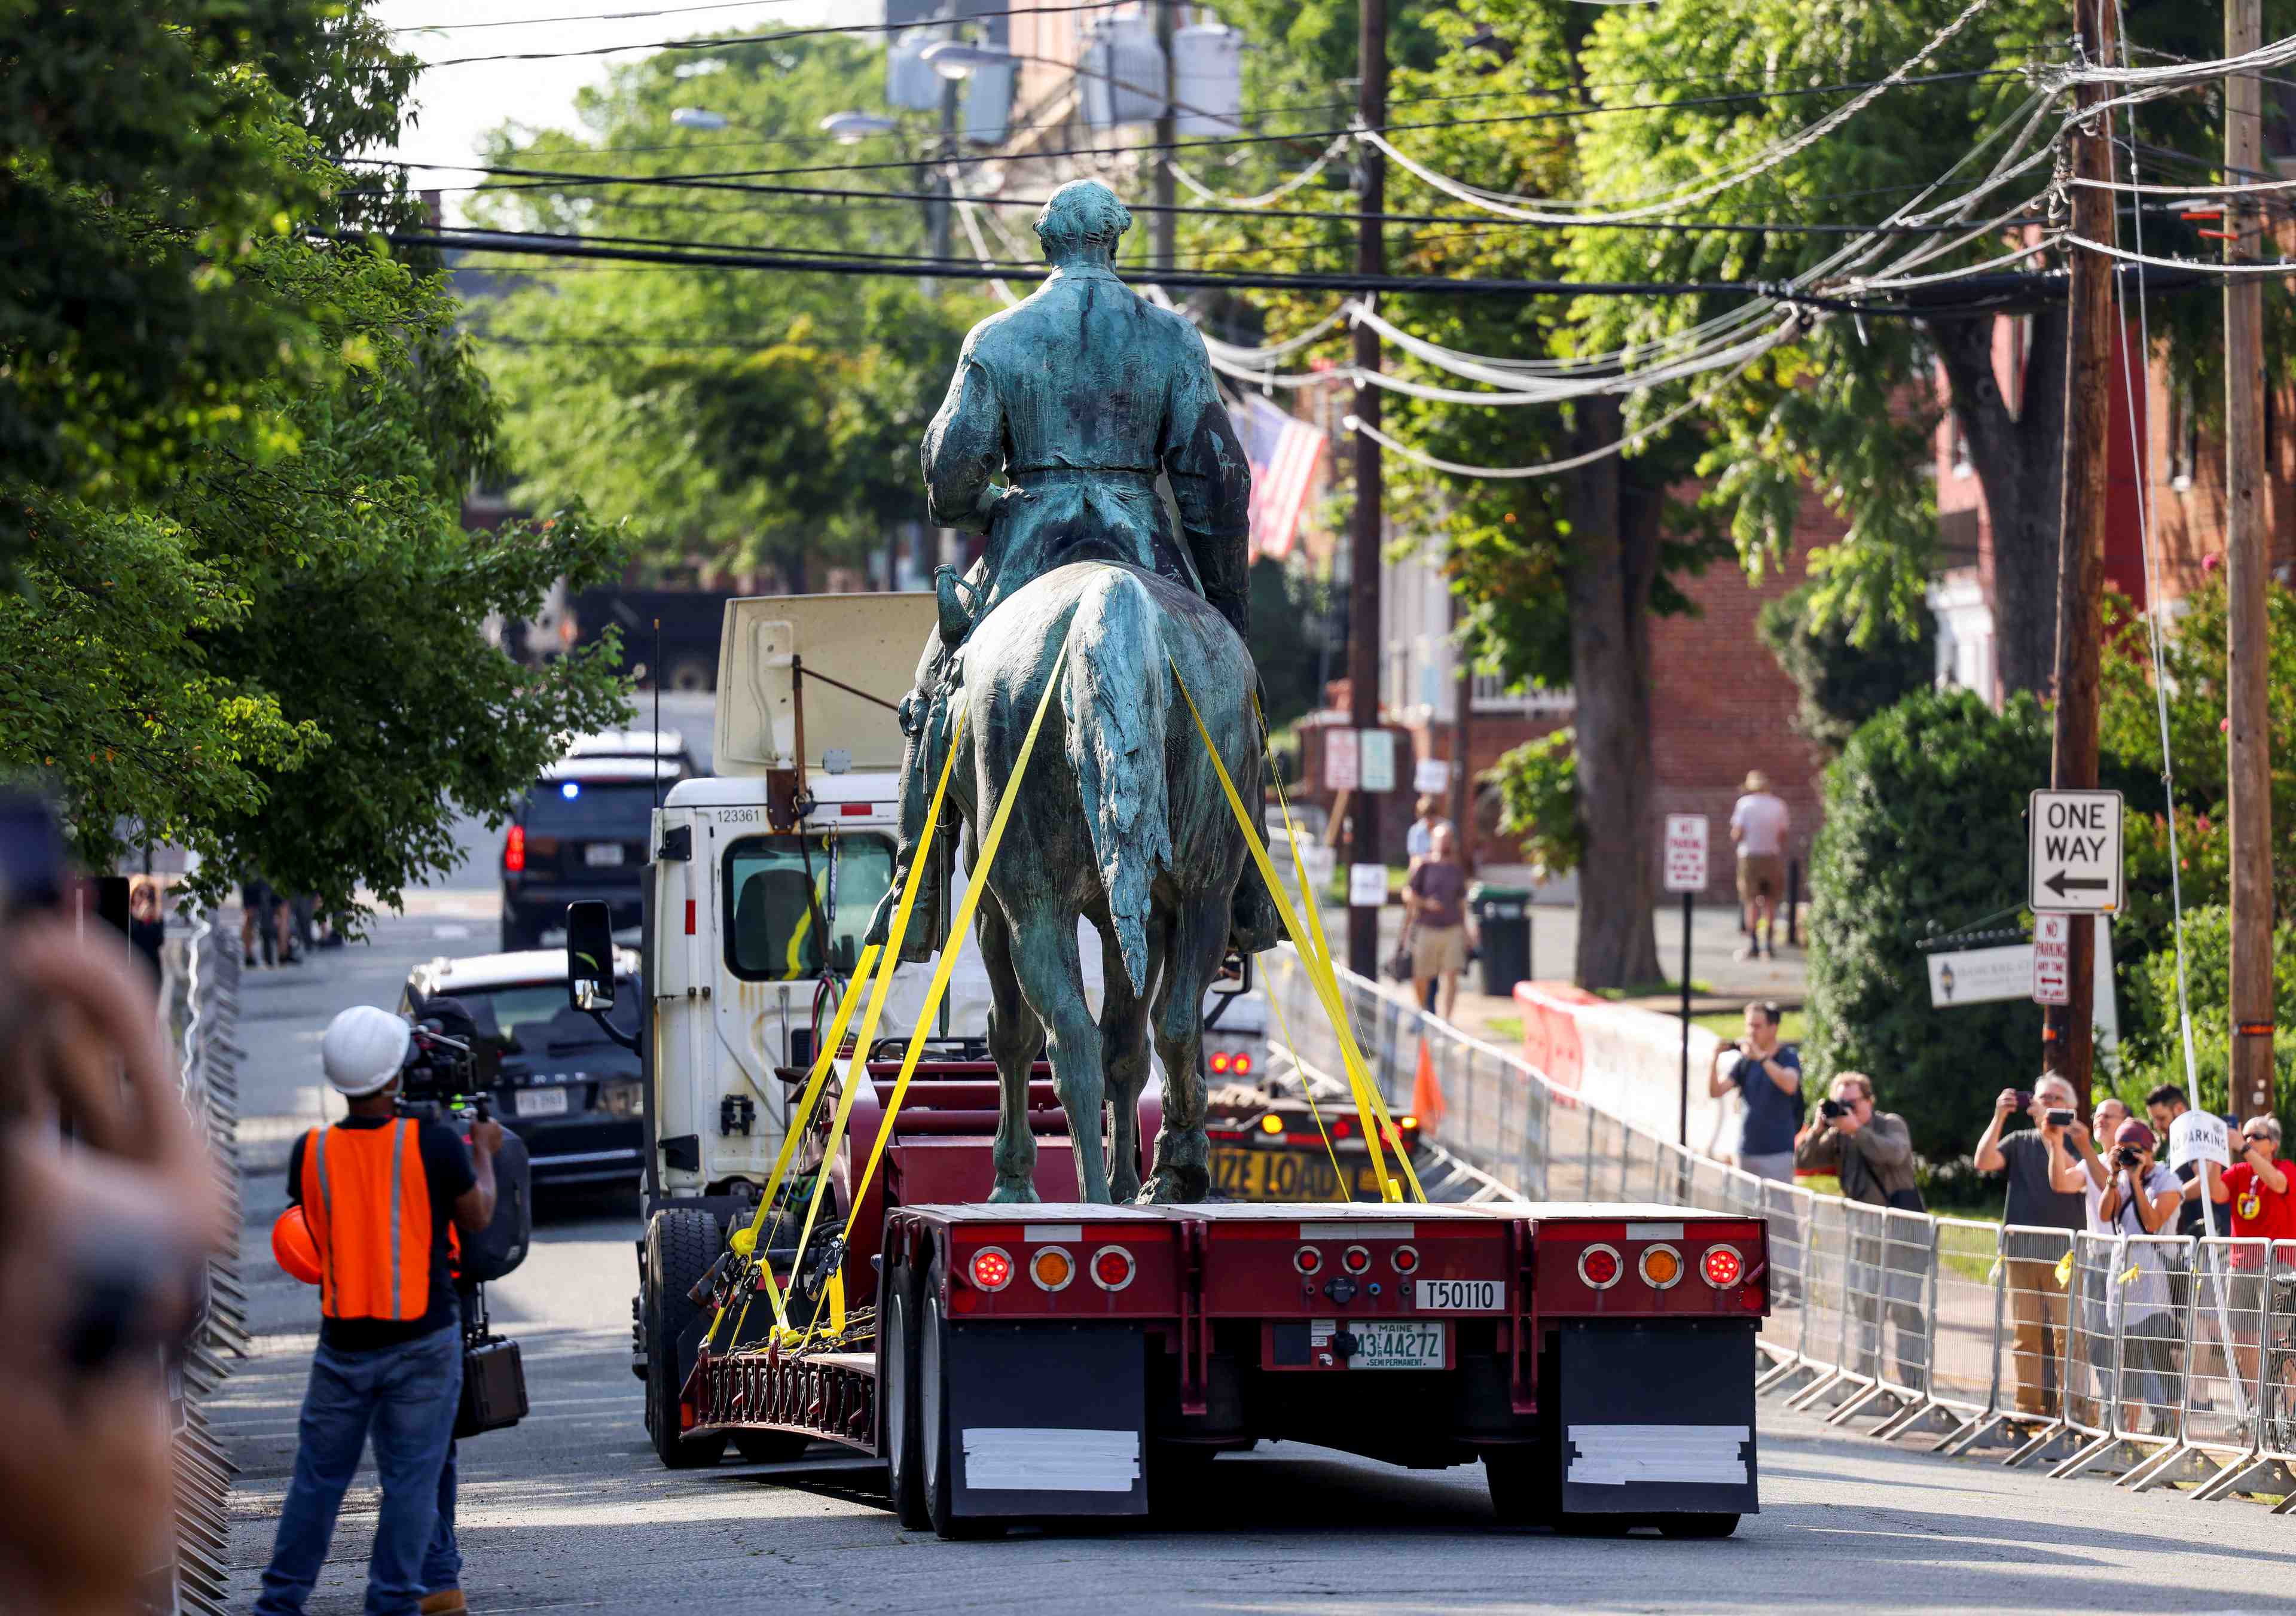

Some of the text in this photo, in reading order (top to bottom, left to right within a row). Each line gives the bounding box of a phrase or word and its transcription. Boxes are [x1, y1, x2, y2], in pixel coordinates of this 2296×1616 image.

[718, 809, 759, 822] 123361
[2048, 802, 2105, 829] ONE
[2045, 836, 2106, 862] WAY
[2046, 922, 2057, 938] NO
[2037, 941, 2067, 958] PARKING
[2038, 961, 2064, 972] ANY TIME
[2182, 1129, 2227, 1151] PARKING
[1263, 1152, 1338, 1197] LOAD
[1427, 1282, 1494, 1308] T50110
[1385, 1358, 1422, 1367] PERMANENT
